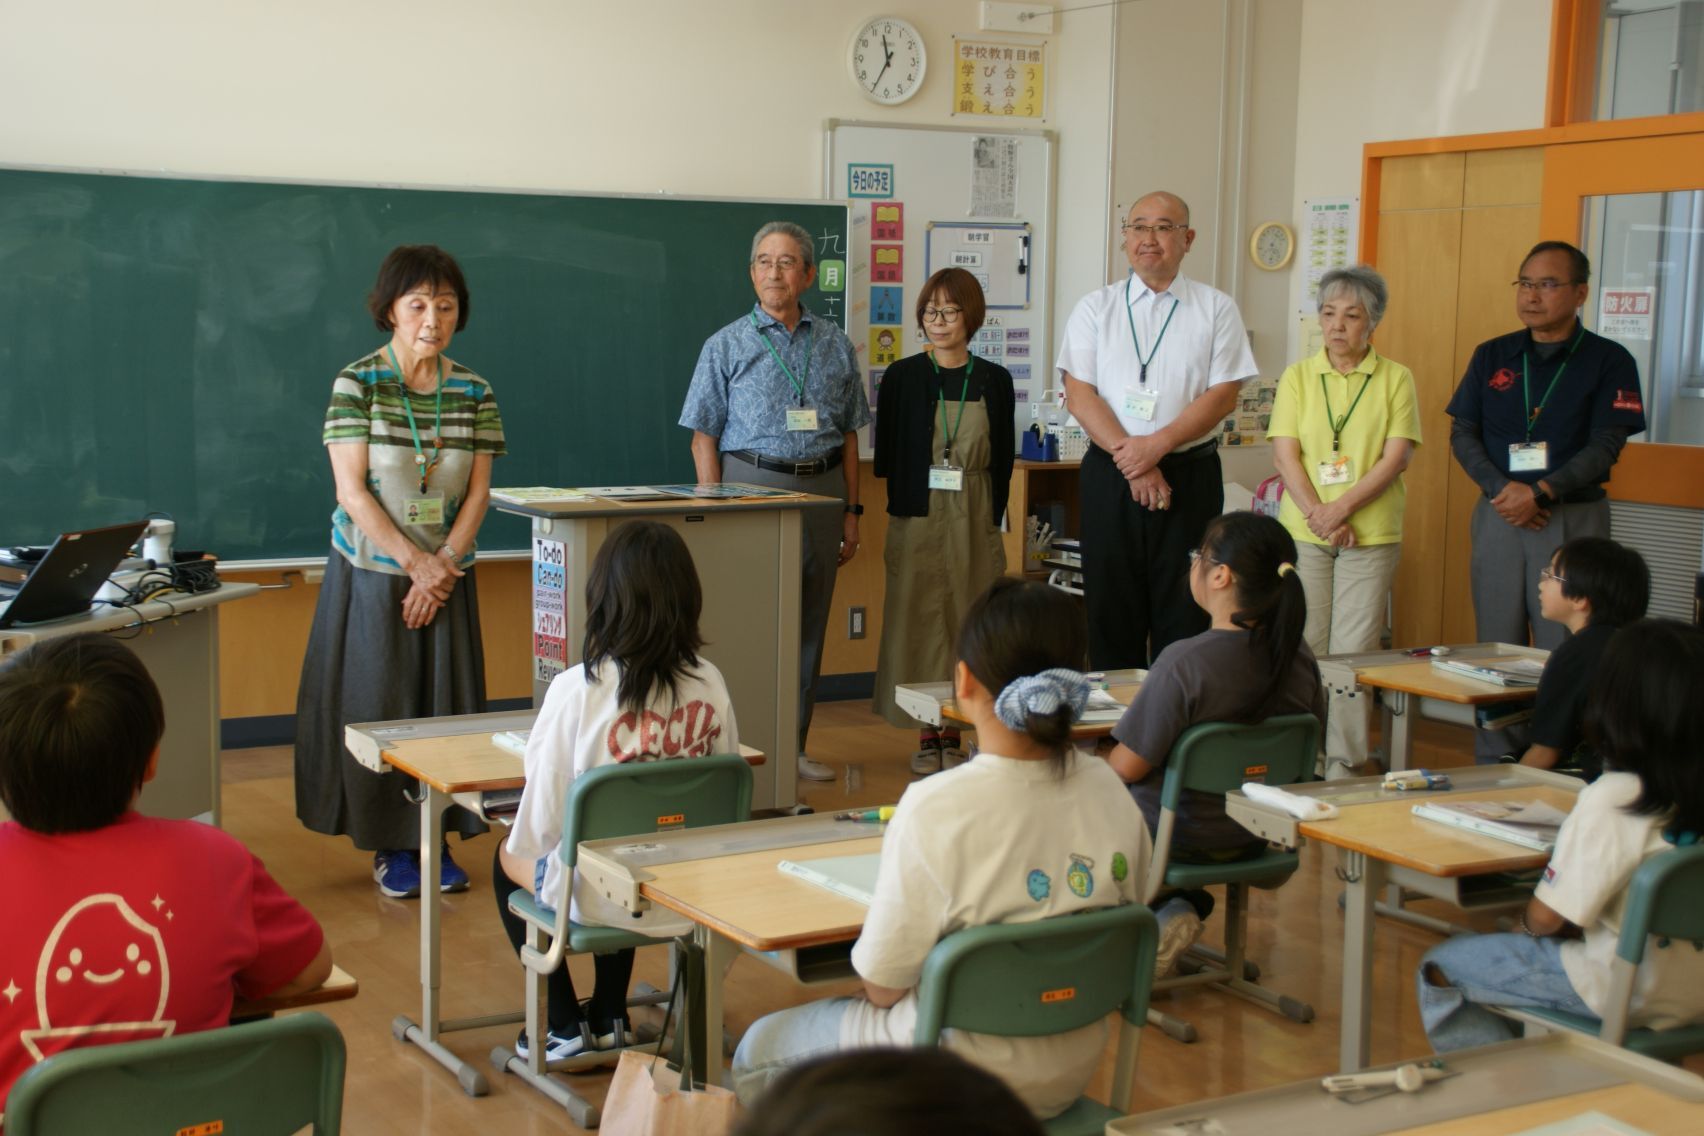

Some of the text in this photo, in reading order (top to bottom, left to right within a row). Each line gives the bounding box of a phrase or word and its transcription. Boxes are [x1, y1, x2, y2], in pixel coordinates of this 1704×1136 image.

[884, 24, 892, 34] 12
[861, 39, 868, 48] 10
[907, 40, 913, 50] 2
[858, 54, 864, 63] 9
[910, 57, 916, 67] 3
[961, 45, 1040, 62] 学校教育目標
[861, 70, 867, 80] 8
[961, 62, 1035, 81] 学び合う
[884, 87, 890, 97] 6
[897, 83, 903, 94] 5
[961, 81, 1034, 98] 支え合う
[852, 169, 889, 192] 今日の予定
[1605, 295, 1649, 313] 防火扉
[537, 539, 562, 565] To-do
[538, 563, 563, 589] Can-do
[537, 611, 562, 637] シェアリング
[537, 633, 563, 661] Point
